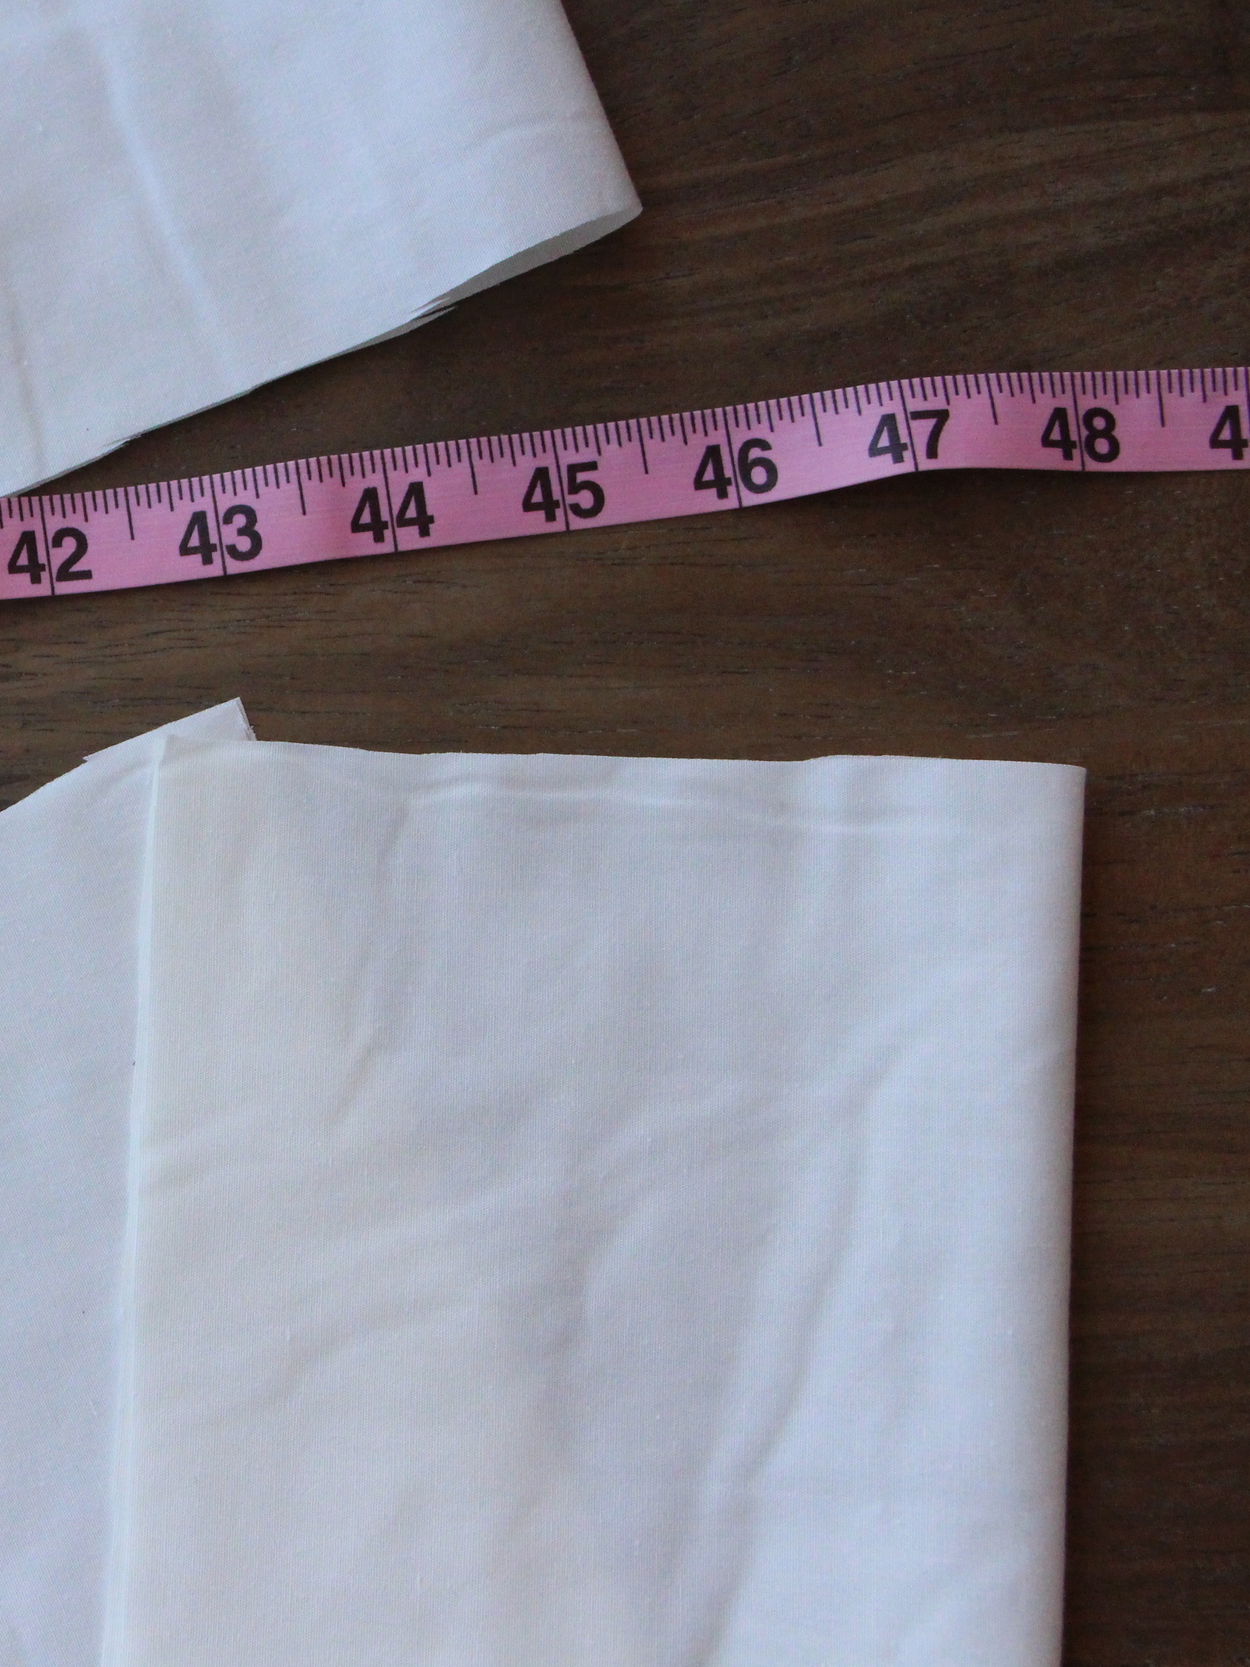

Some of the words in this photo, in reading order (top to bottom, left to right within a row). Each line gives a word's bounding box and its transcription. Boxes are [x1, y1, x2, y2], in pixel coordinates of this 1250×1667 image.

[7, 527, 93, 585] 42
[178, 504, 263, 566] 43
[350, 481, 435, 544] 44
[522, 460, 606, 523] 45
[693, 437, 779, 501] 46
[867, 408, 950, 465] 47
[1041, 406, 1121, 464] 48
[1209, 404, 1250, 461] 4
